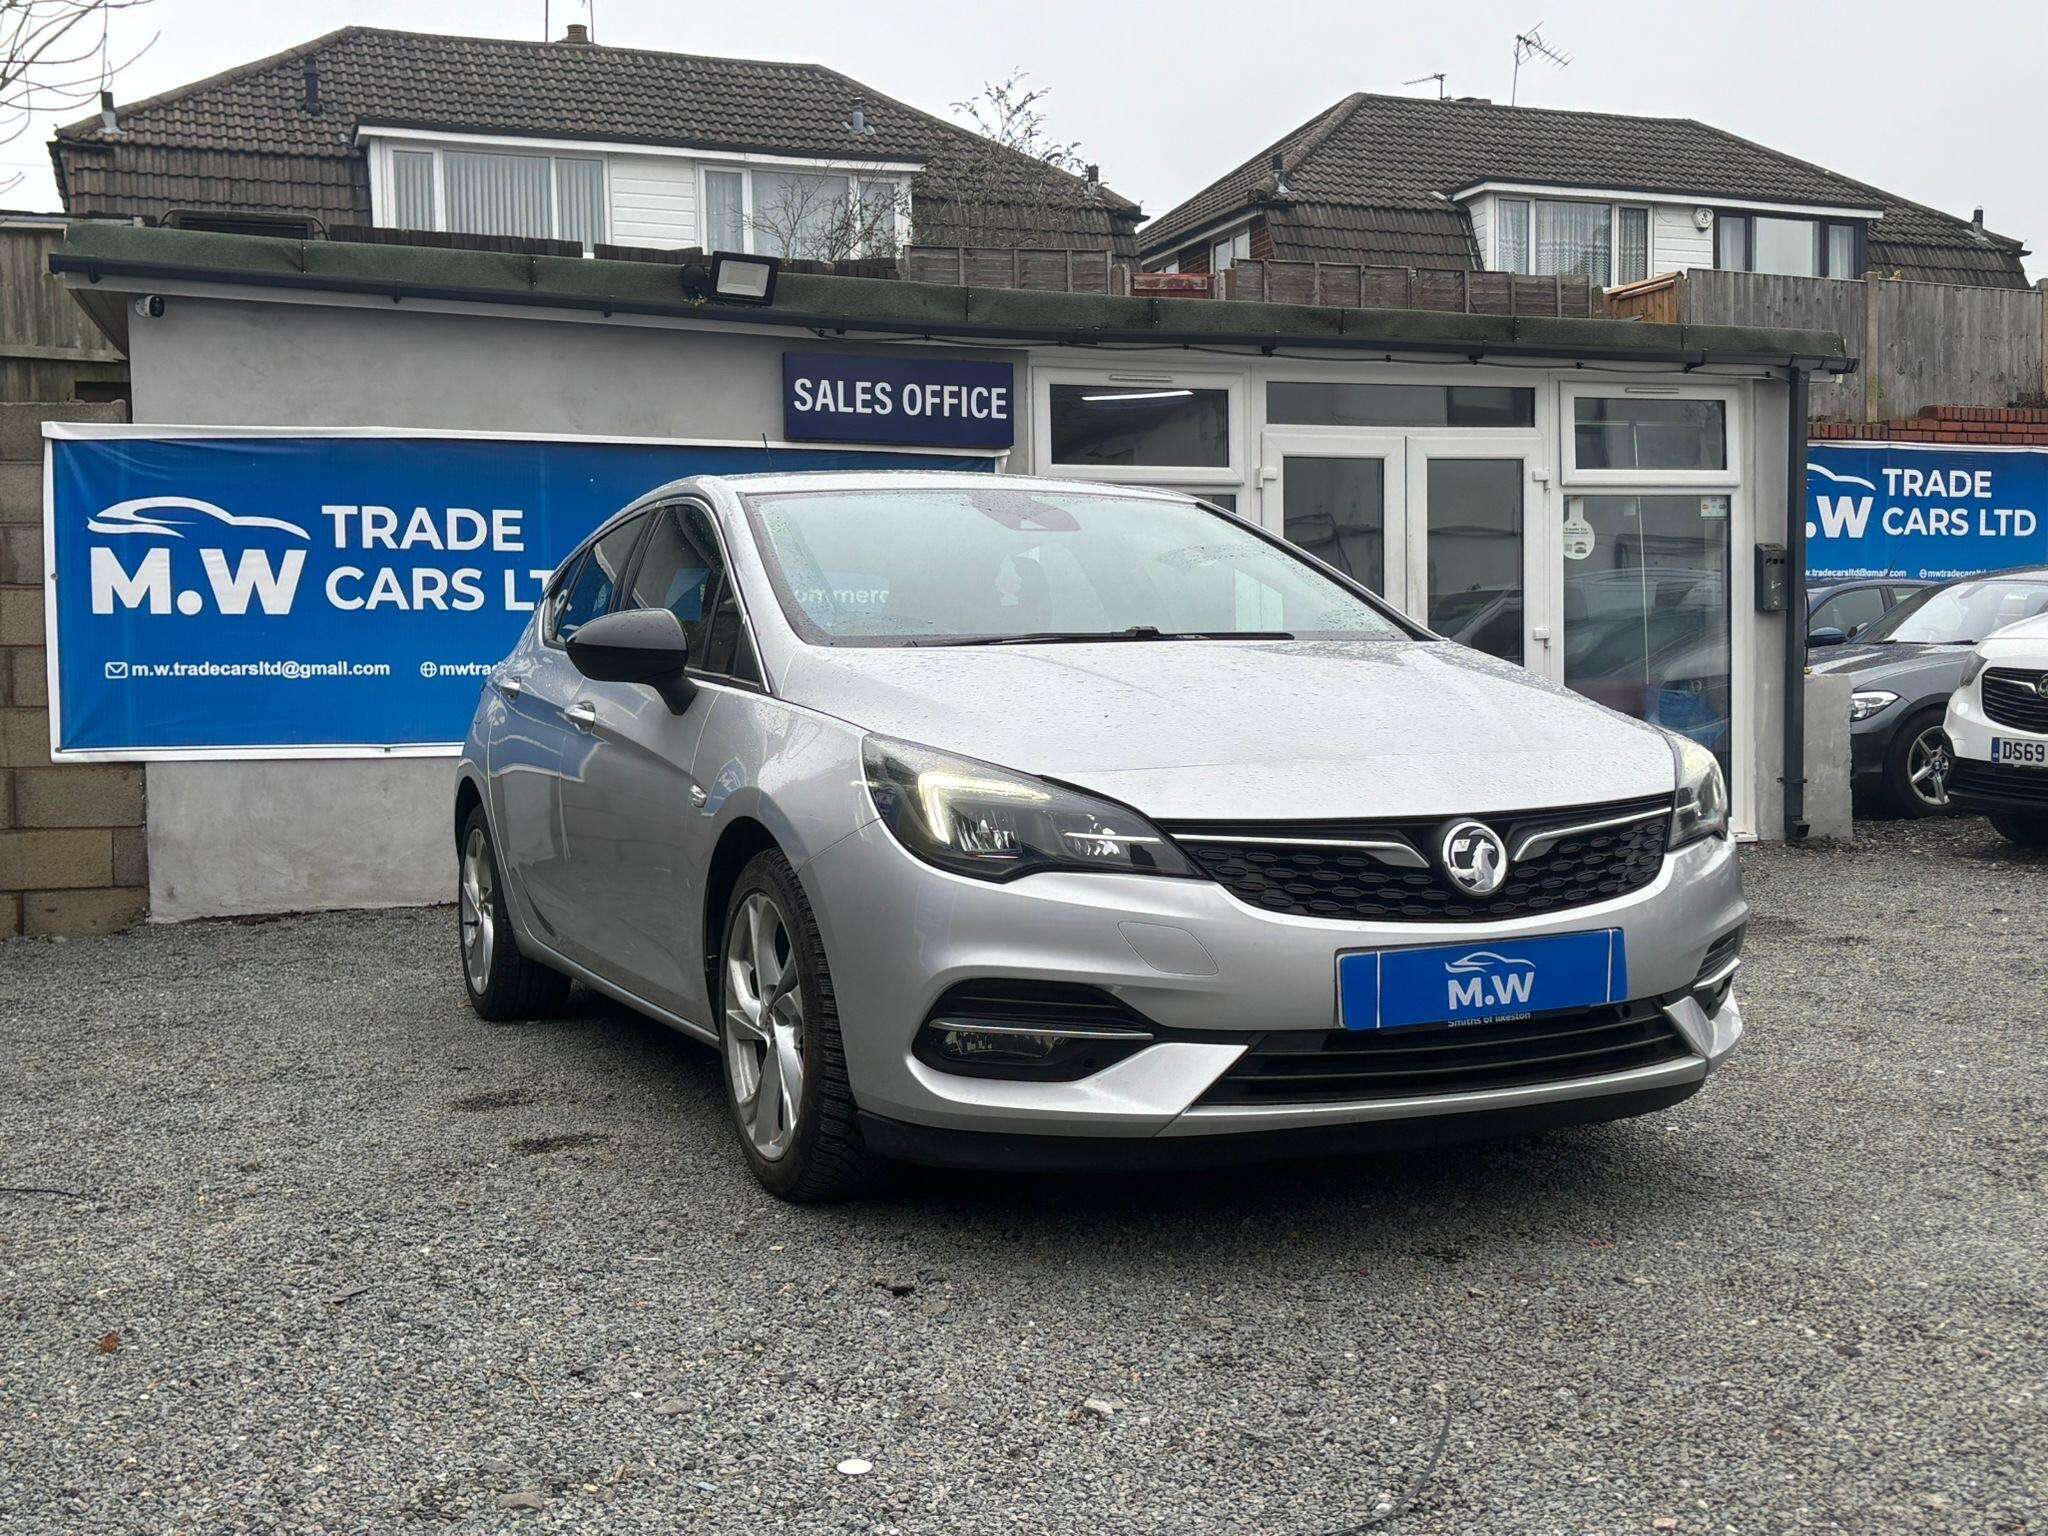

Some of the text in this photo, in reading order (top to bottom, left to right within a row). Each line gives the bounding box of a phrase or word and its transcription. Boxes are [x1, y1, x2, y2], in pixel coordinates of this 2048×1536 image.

[793, 378, 1008, 420] SALES OFFICE
[1882, 468, 1992, 498] TRADE
[321, 505, 524, 552] TRADE
[1882, 507, 2037, 537] CARS LTD
[90, 547, 307, 616] M.W
[325, 566, 485, 611] CARS
[131, 660, 390, 679] m.w.tradecarsltd@gmail.com
[2002, 741, 2046, 763] DS69
[1446, 971, 1535, 1010] M.W
